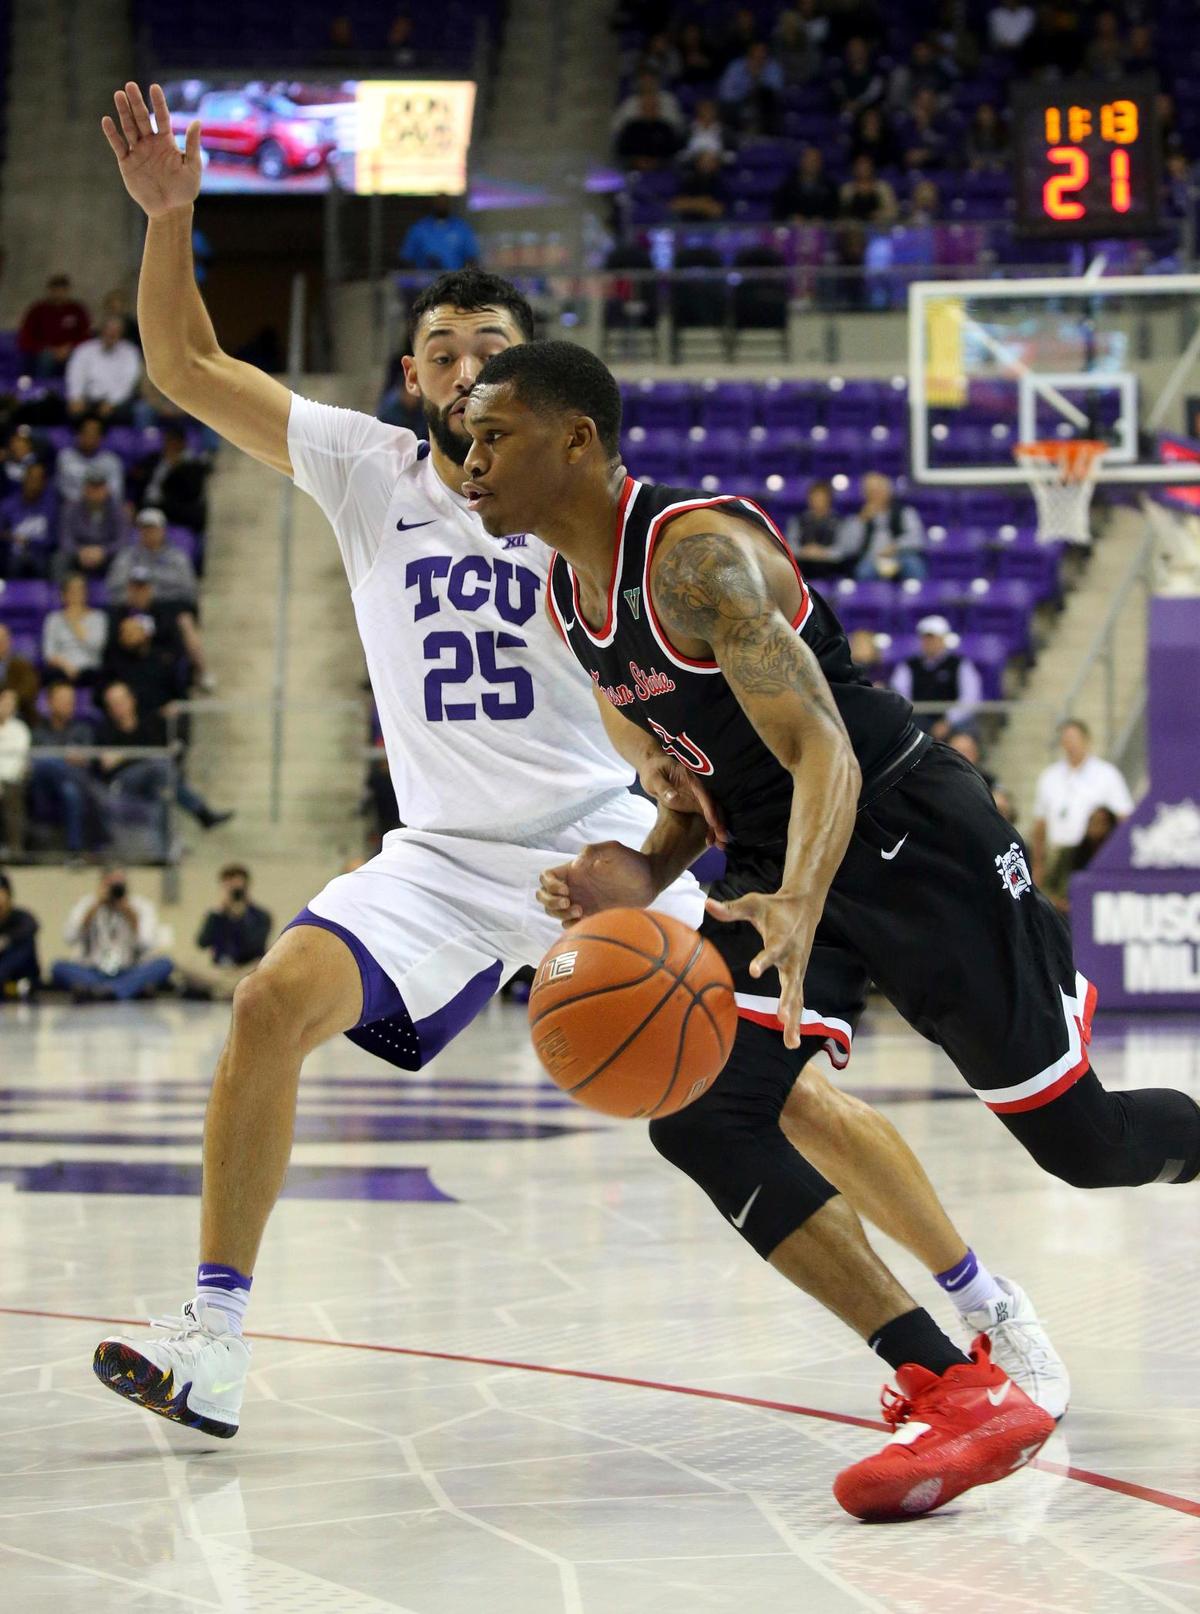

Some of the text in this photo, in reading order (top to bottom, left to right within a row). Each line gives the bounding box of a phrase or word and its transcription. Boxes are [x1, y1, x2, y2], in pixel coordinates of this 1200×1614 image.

[1043, 147, 1131, 220] 21
[405, 555, 541, 627] TCU
[623, 587, 641, 620] V
[423, 631, 535, 721] 25
[630, 661, 676, 701] State
